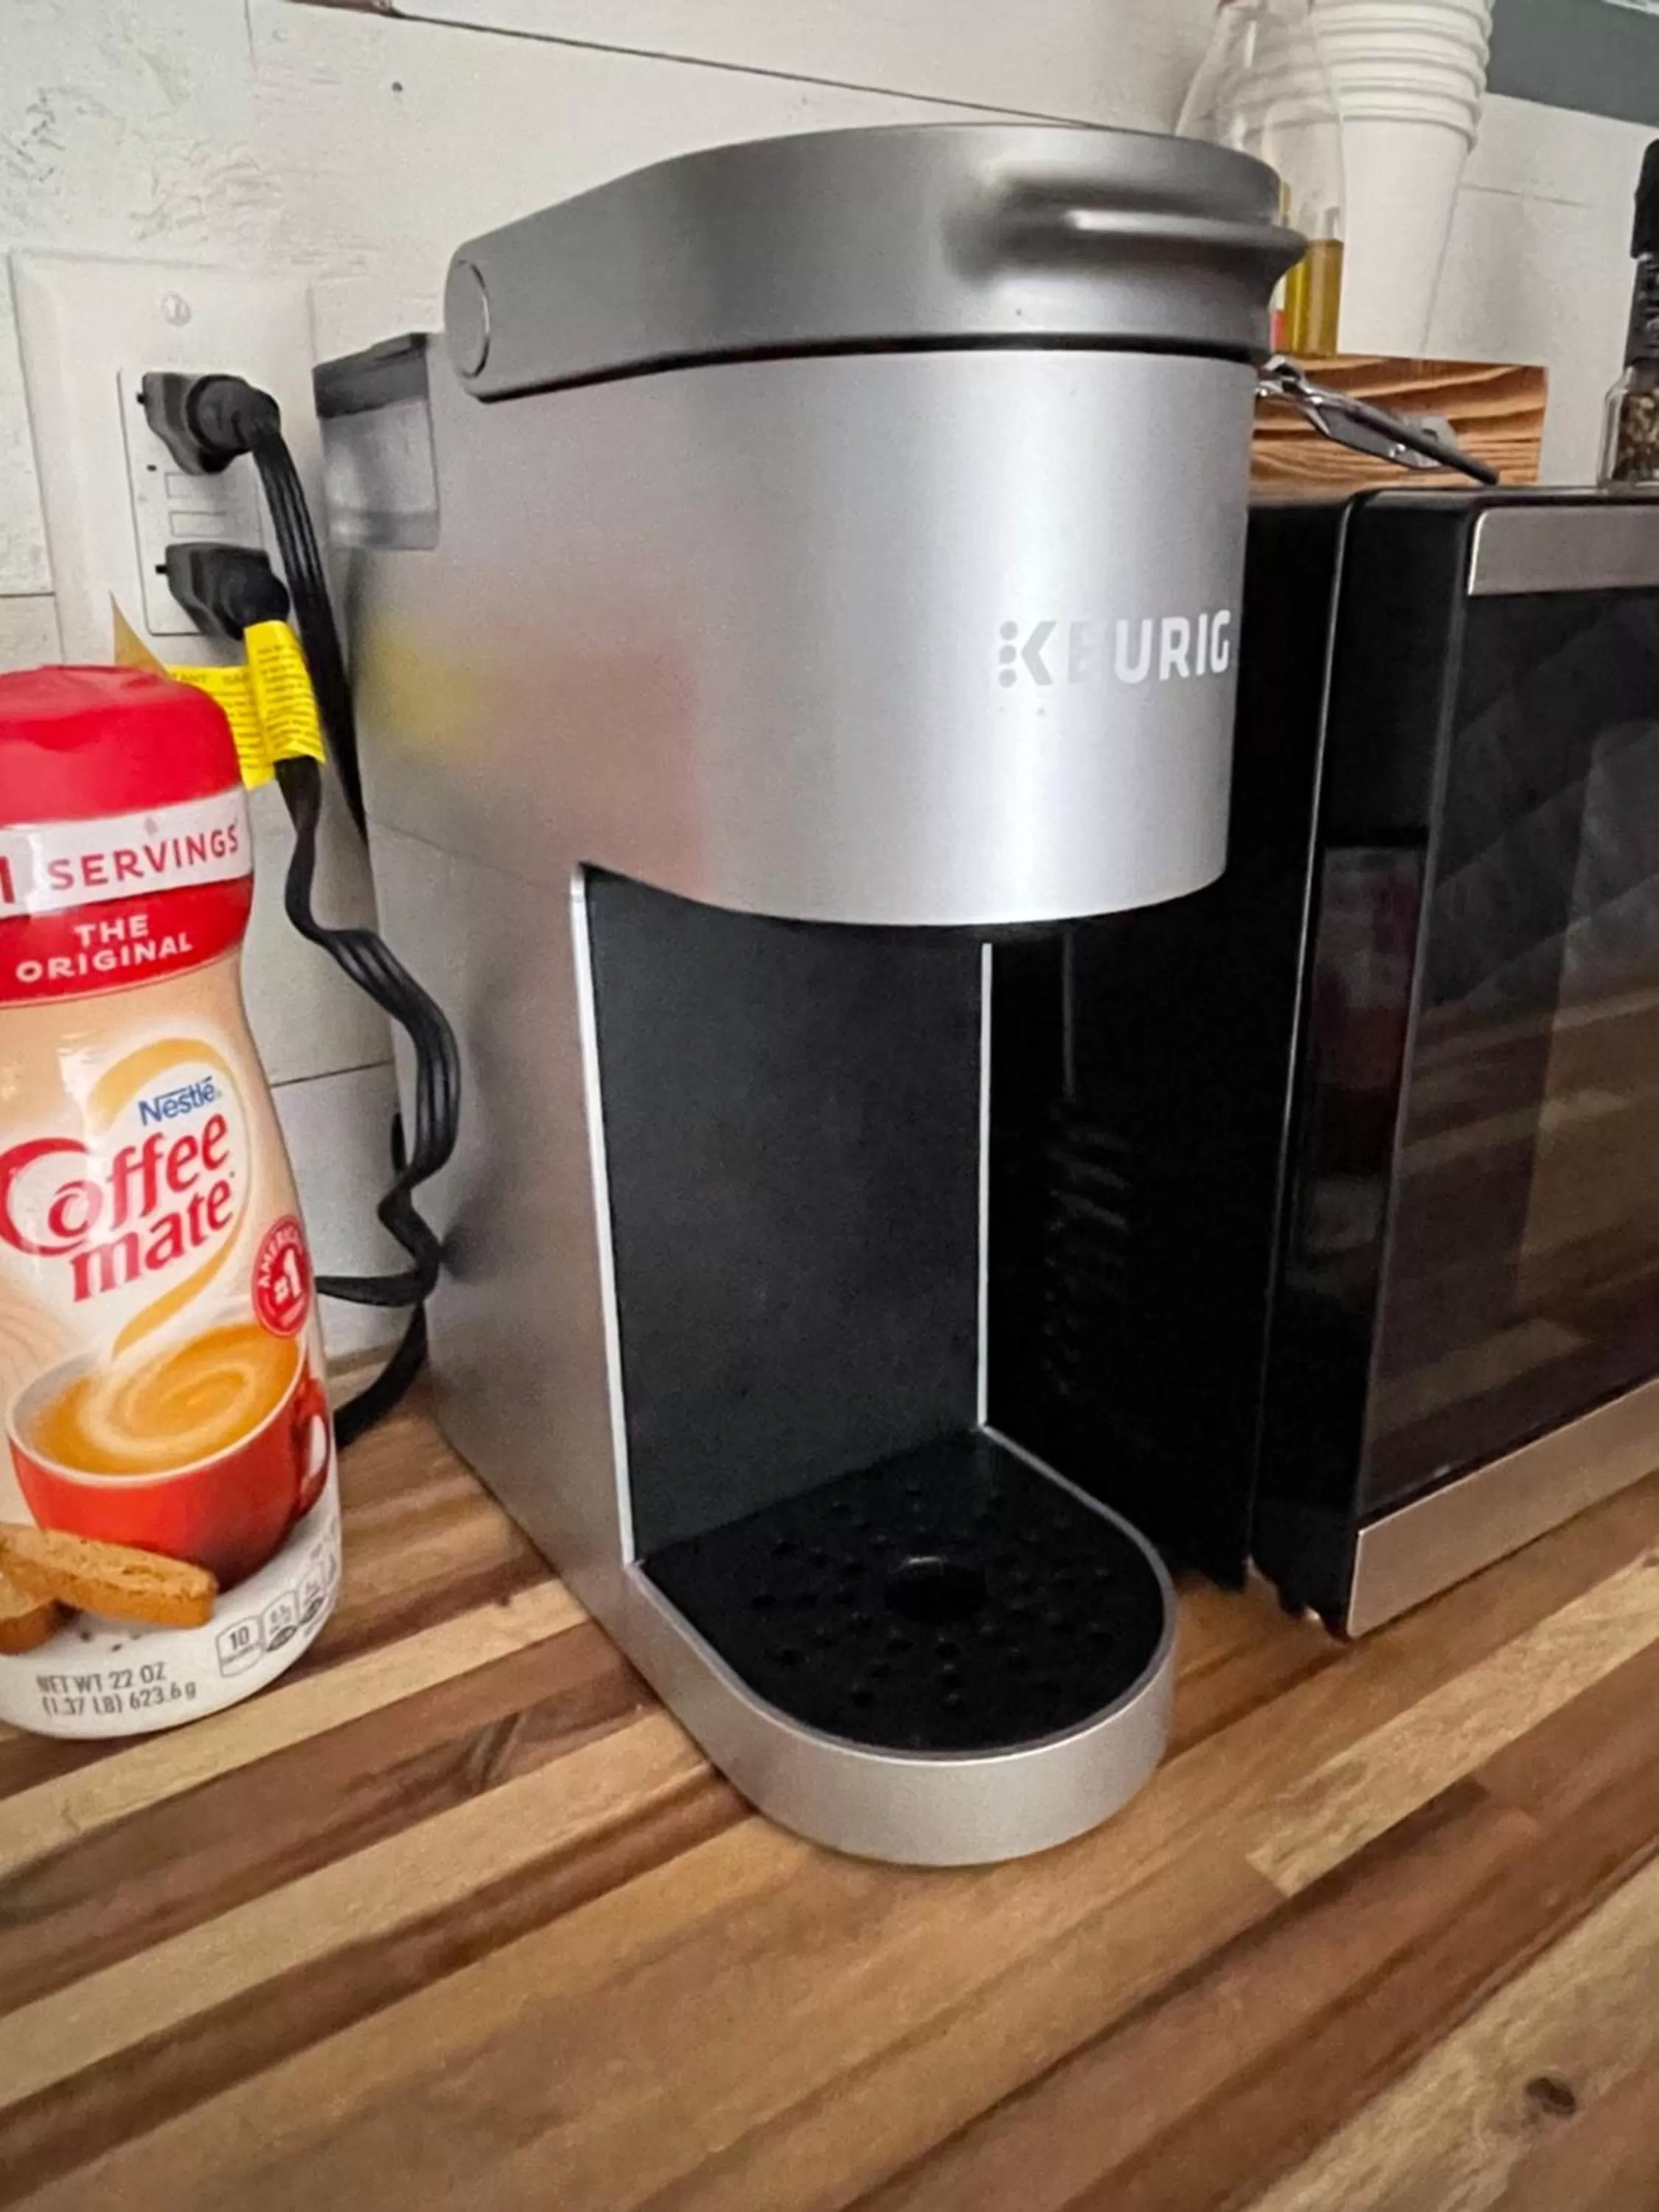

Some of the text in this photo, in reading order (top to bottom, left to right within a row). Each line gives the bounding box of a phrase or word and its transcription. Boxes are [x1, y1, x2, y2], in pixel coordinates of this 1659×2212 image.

[997, 608, 1231, 689] KEURIG
[47, 824, 240, 891] SERVINGS
[73, 914, 150, 948] THE
[15, 932, 193, 984] ORIGINAL
[138, 1074, 215, 1127] Nestlé
[0, 1113, 230, 1258] Coffee
[70, 1178, 234, 1304] mate
[229, 1626, 249, 1652] 10
[36, 1660, 167, 1694] NET WT 22 OZ
[41, 1696, 85, 1717] (1.37
[92, 1694, 123, 1714] LB)
